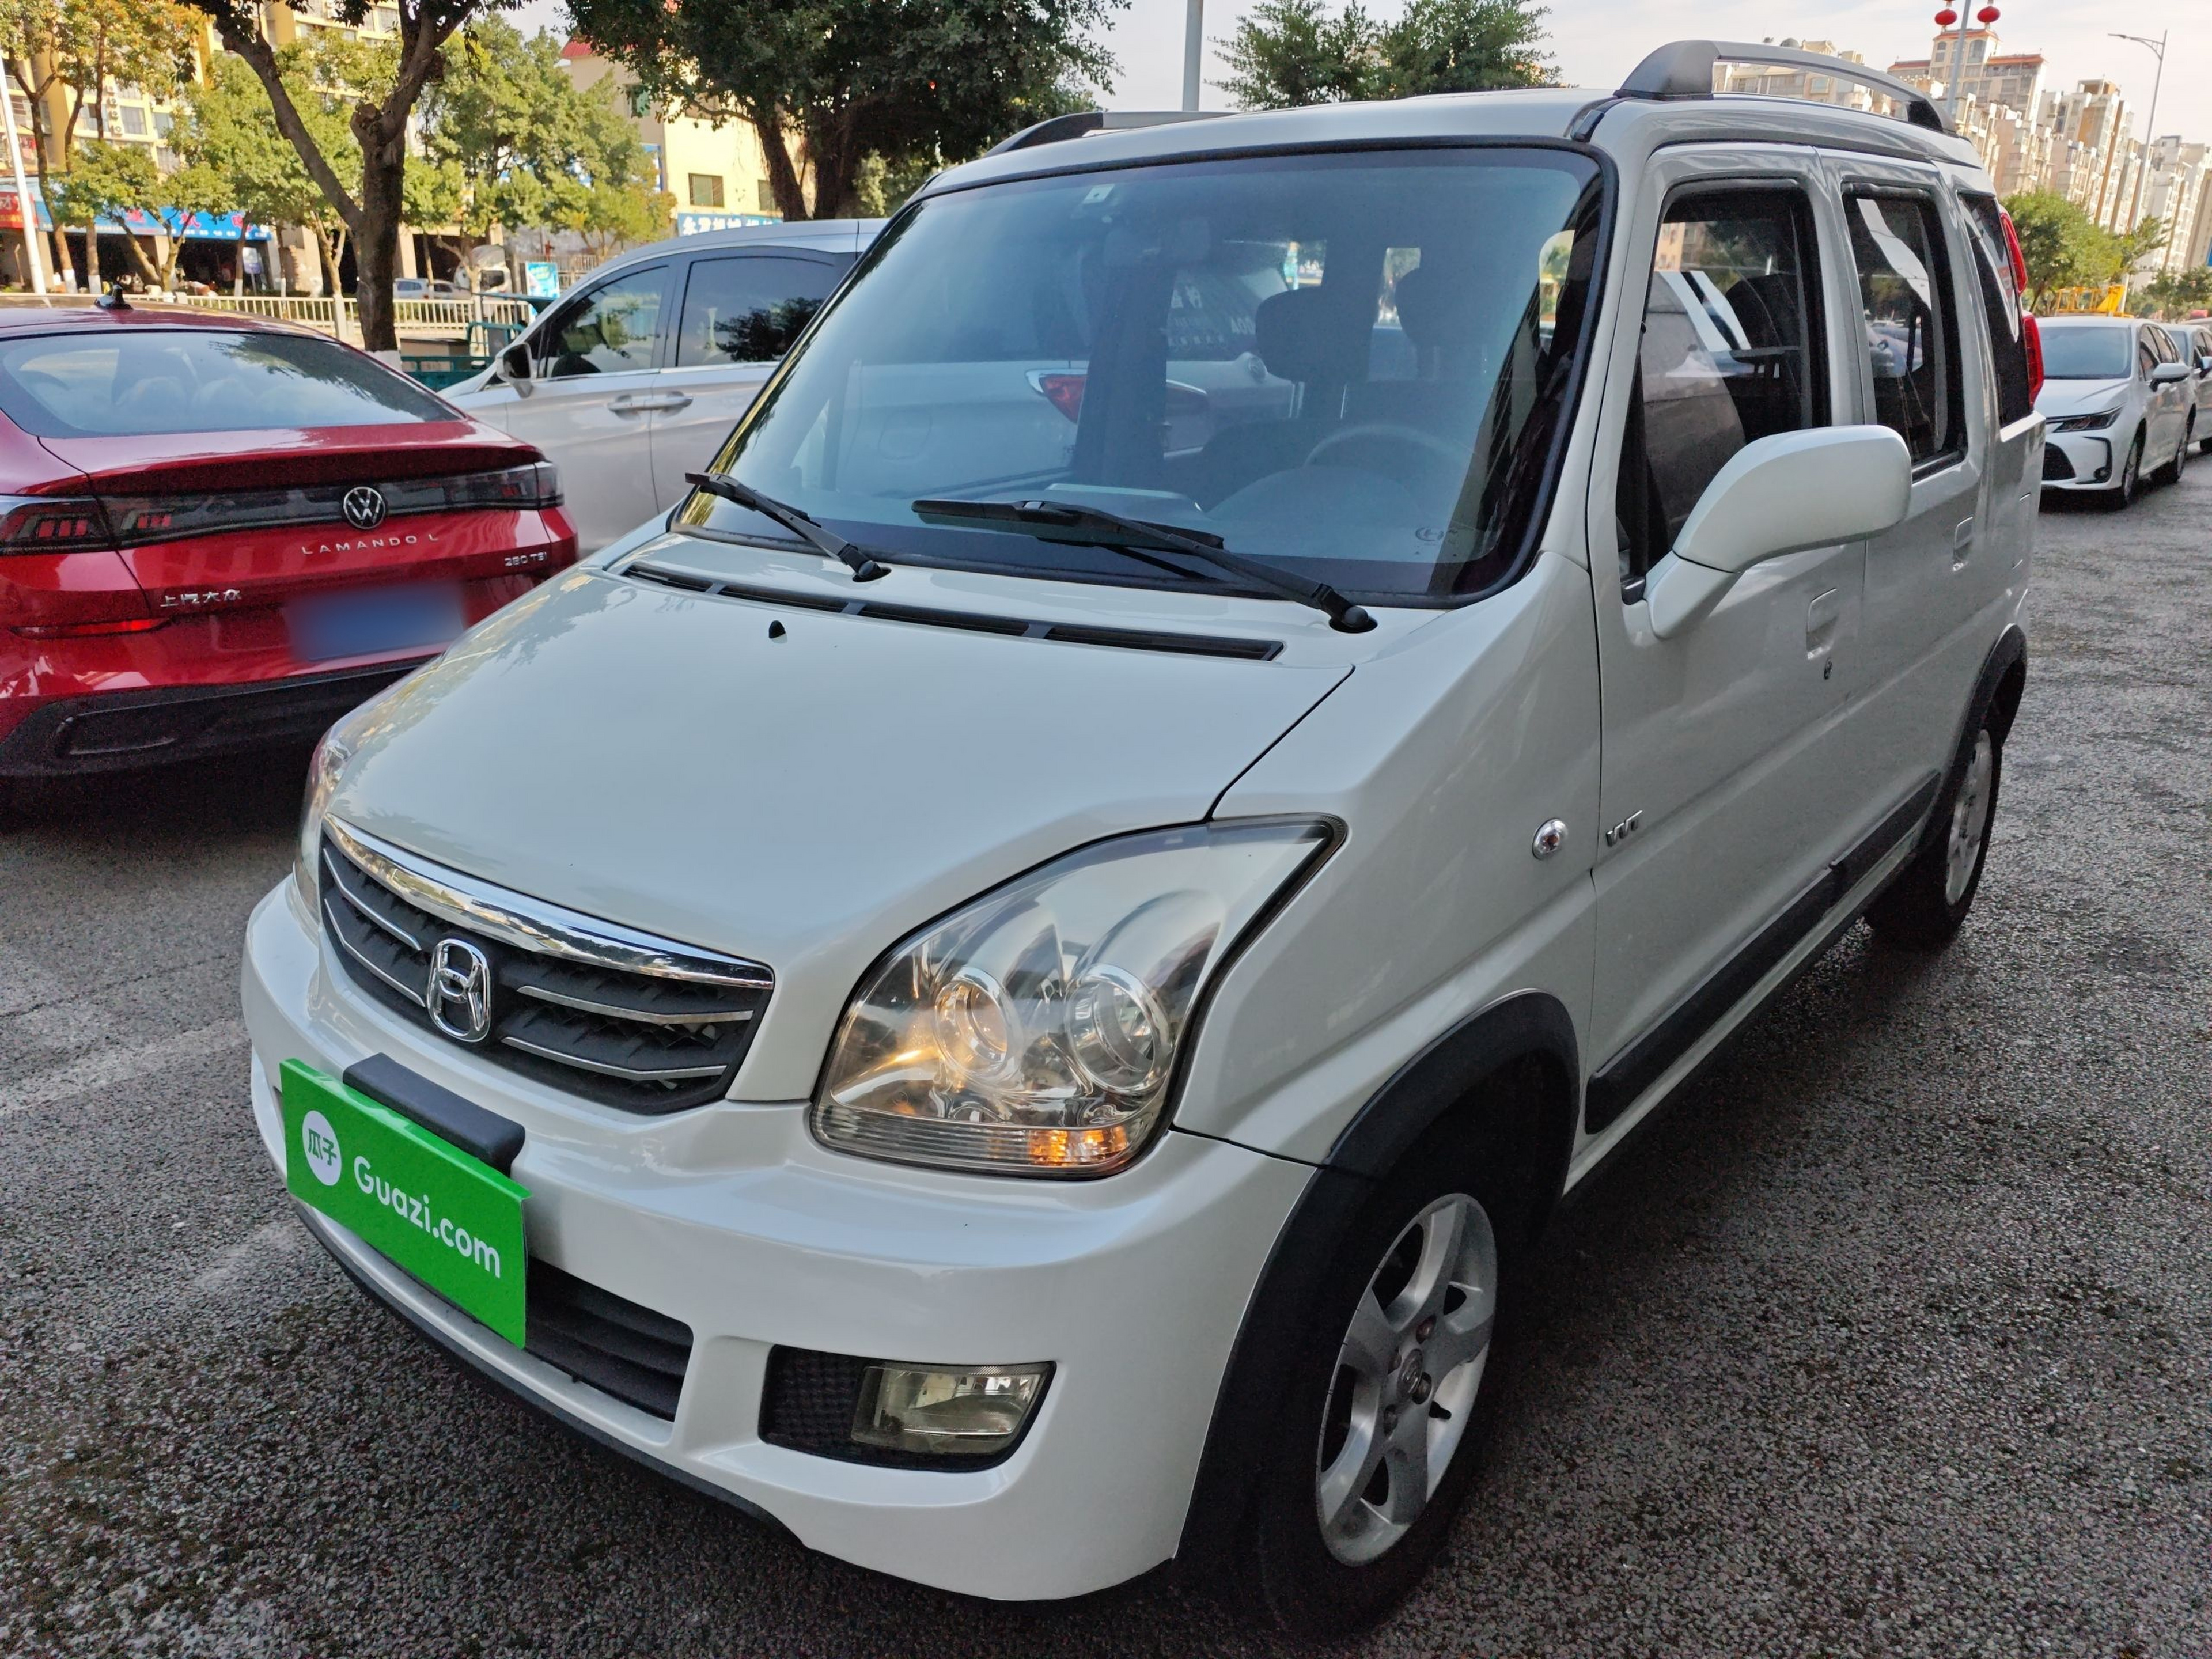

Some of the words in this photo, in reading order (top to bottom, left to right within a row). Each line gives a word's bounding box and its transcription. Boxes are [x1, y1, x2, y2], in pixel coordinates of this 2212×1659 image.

[301, 535, 418, 555] LAMANDO
[428, 533, 439, 541] L
[504, 555, 528, 567] 280
[529, 551, 547, 562] TSI
[160, 589, 242, 607] 上汽大众
[308, 1128, 338, 1166] 瓜子
[354, 1155, 501, 1279] Guazi.com
